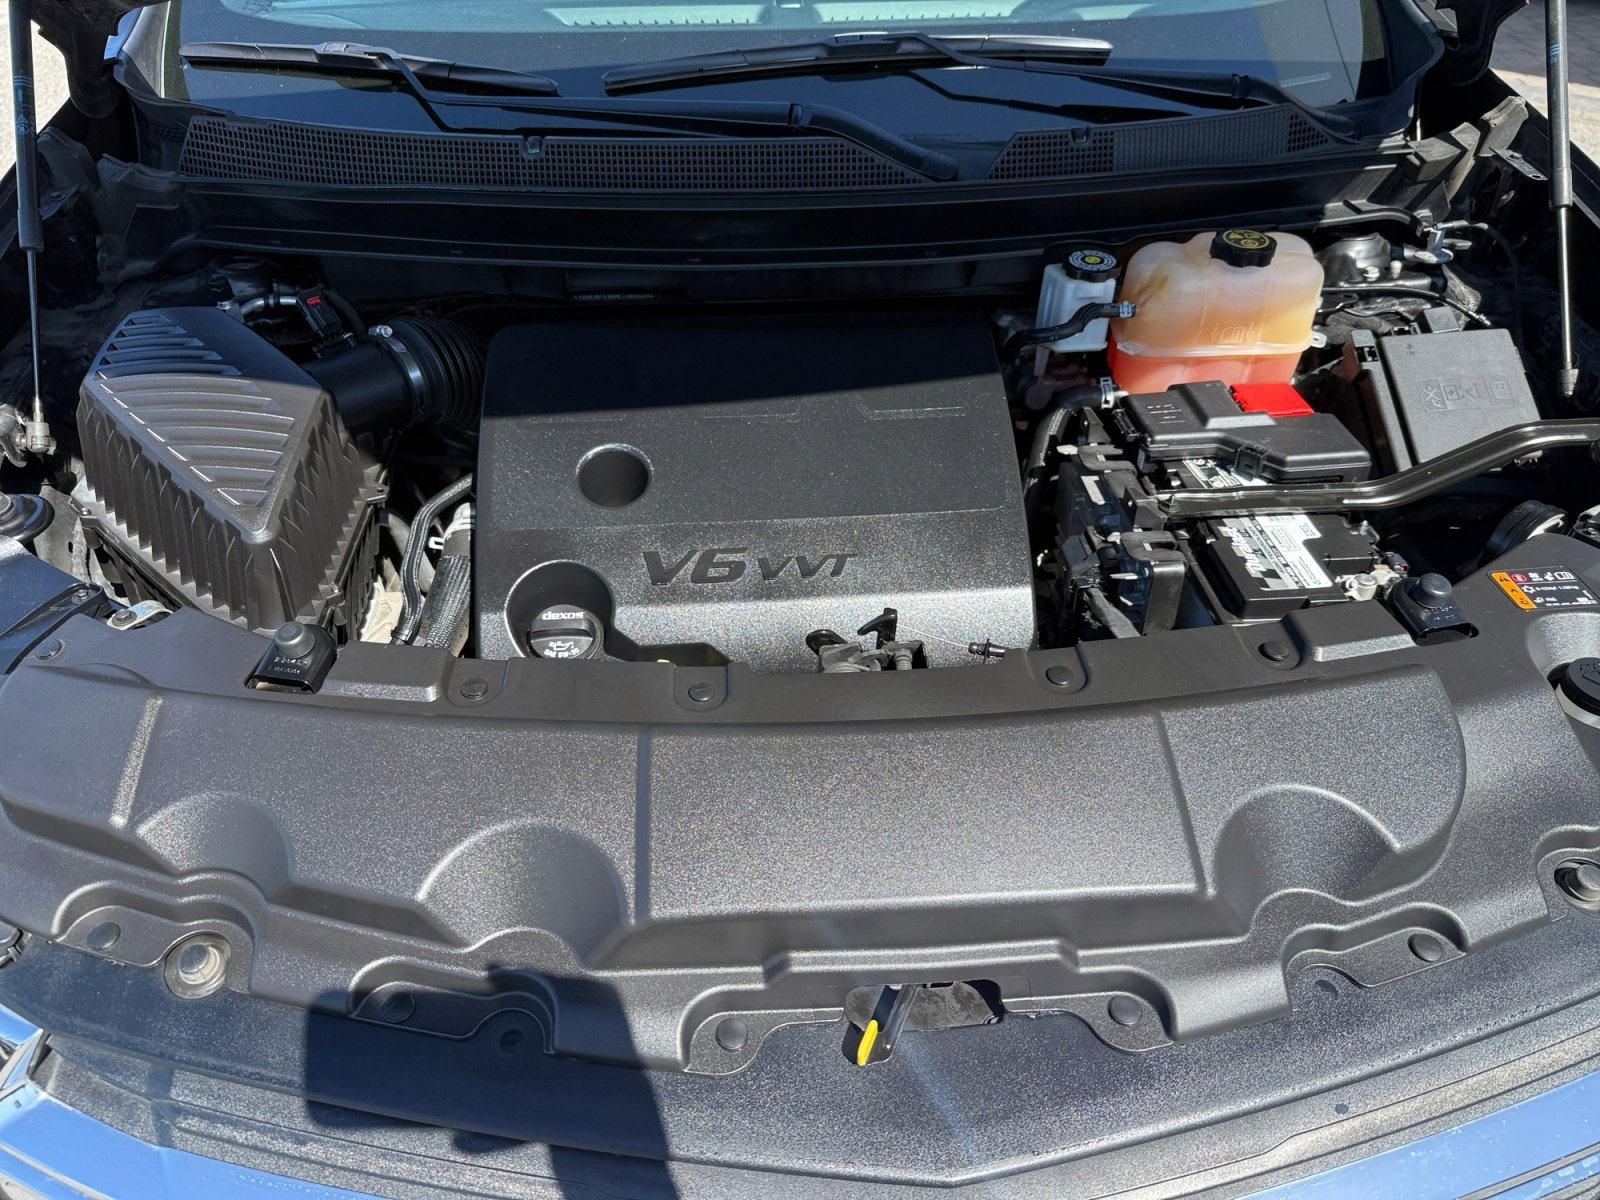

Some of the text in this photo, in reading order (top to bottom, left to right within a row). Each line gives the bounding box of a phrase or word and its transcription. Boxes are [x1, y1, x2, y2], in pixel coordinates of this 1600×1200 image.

[642, 548, 859, 585] V6 VVT
[1218, 526, 1267, 573] Duralast
[542, 611, 586, 620] dexos
